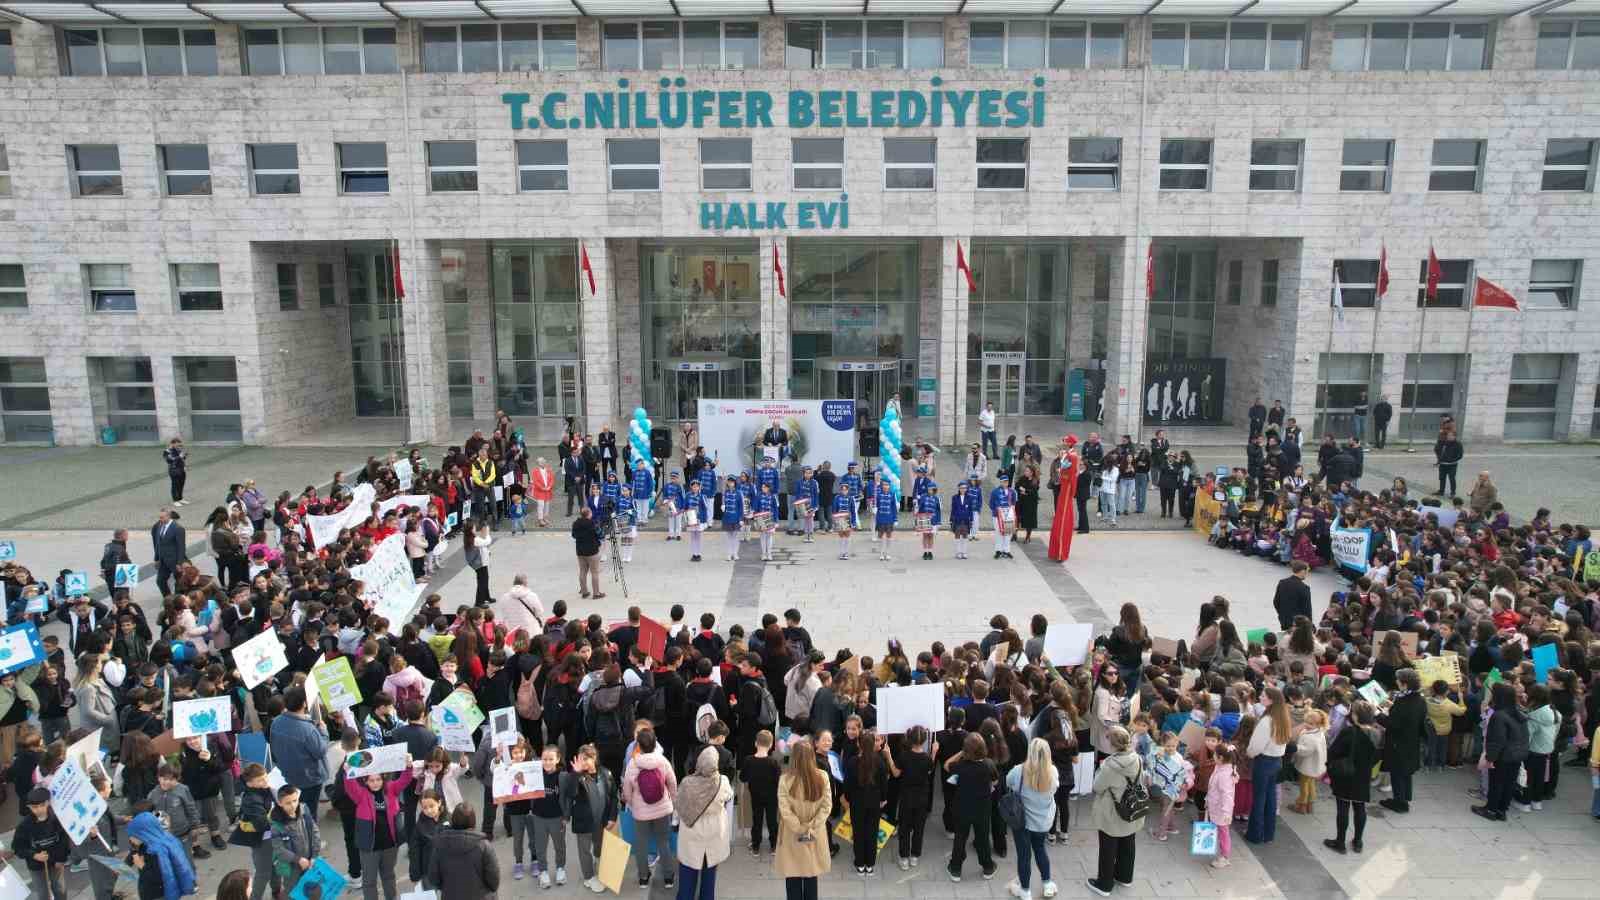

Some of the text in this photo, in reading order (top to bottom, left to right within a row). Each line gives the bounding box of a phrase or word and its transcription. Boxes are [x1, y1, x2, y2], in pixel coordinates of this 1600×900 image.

[787, 75, 1047, 128] BELEDİYESİ
[699, 192, 849, 231] HALK EVİ
